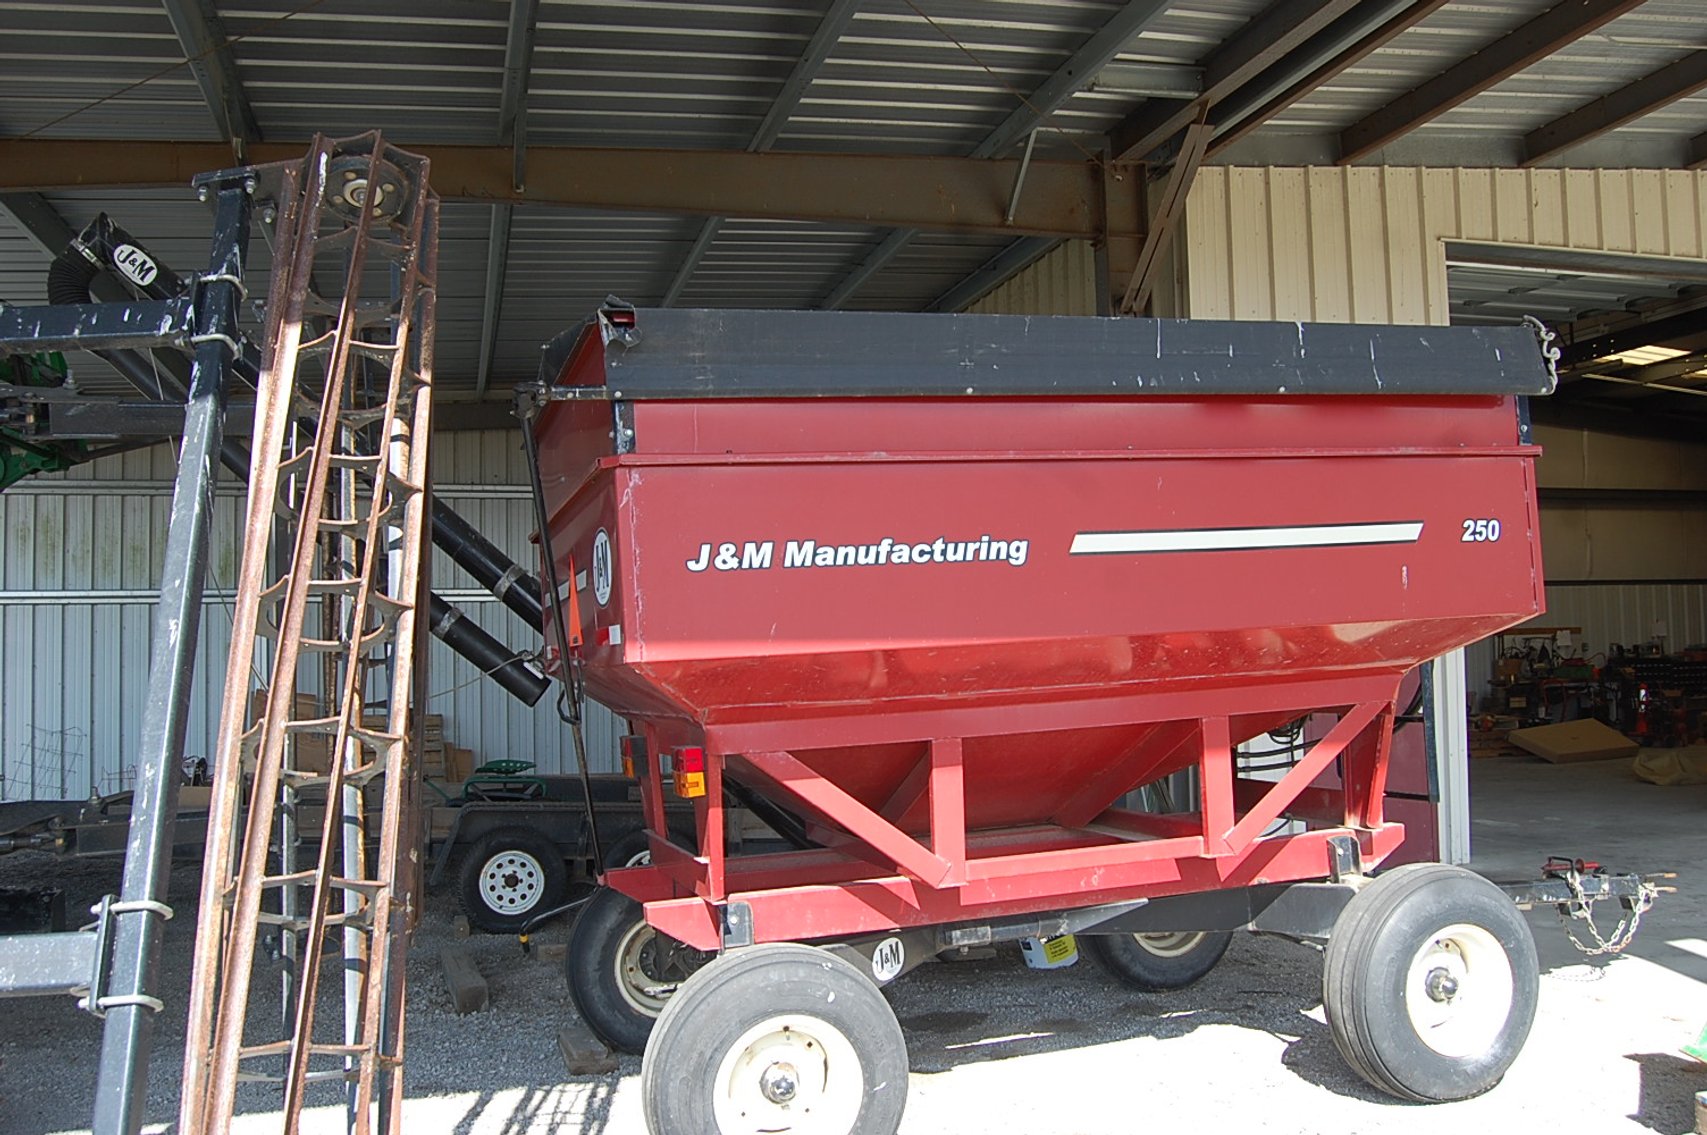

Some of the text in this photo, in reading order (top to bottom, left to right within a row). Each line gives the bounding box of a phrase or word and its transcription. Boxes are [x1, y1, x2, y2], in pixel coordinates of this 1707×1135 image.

[117, 249, 156, 283] J&M
[1461, 518, 1501, 542] 250
[594, 540, 610, 592] J&M
[686, 535, 1029, 572] J&M Manufacturing
[875, 941, 901, 973] J&M
